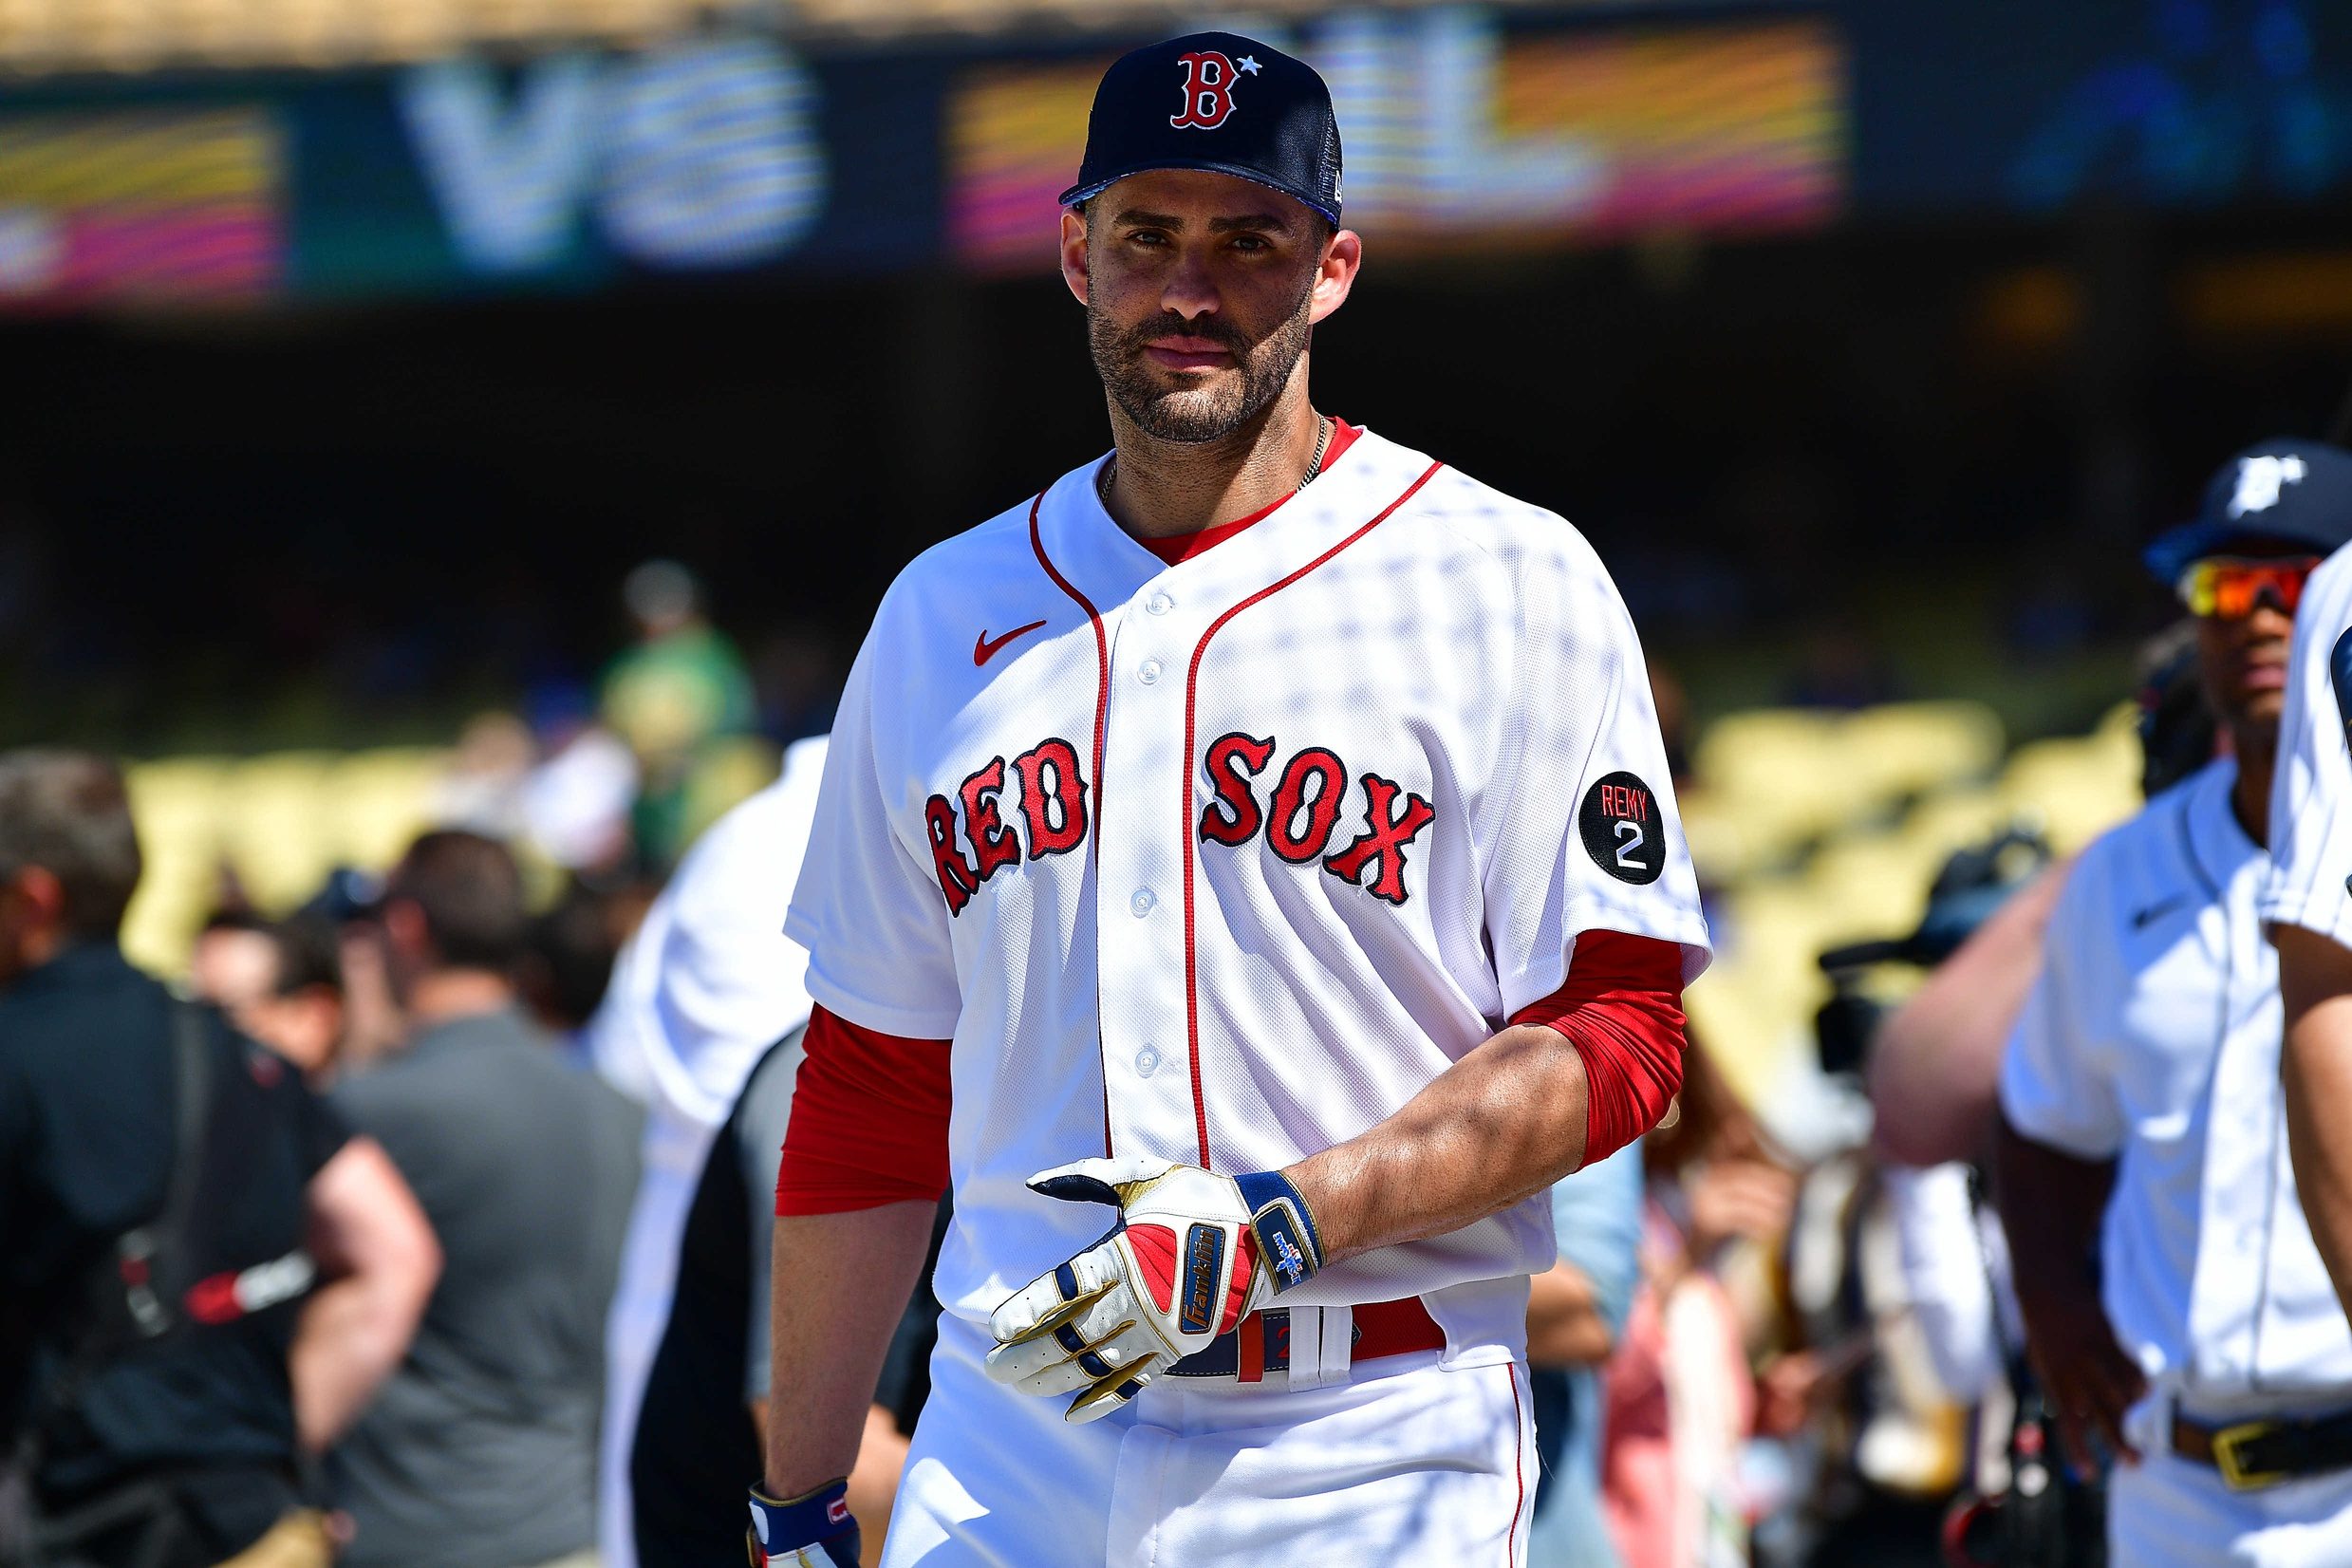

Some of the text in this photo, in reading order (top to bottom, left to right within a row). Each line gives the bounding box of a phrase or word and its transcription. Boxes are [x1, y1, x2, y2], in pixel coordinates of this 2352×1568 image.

[1169, 50, 1241, 130] B
[924, 731, 1436, 918] RED SOX
[1601, 784, 1649, 822] REMY
[1614, 819, 1648, 870] 2
[1185, 1228, 1216, 1329] Franklin
